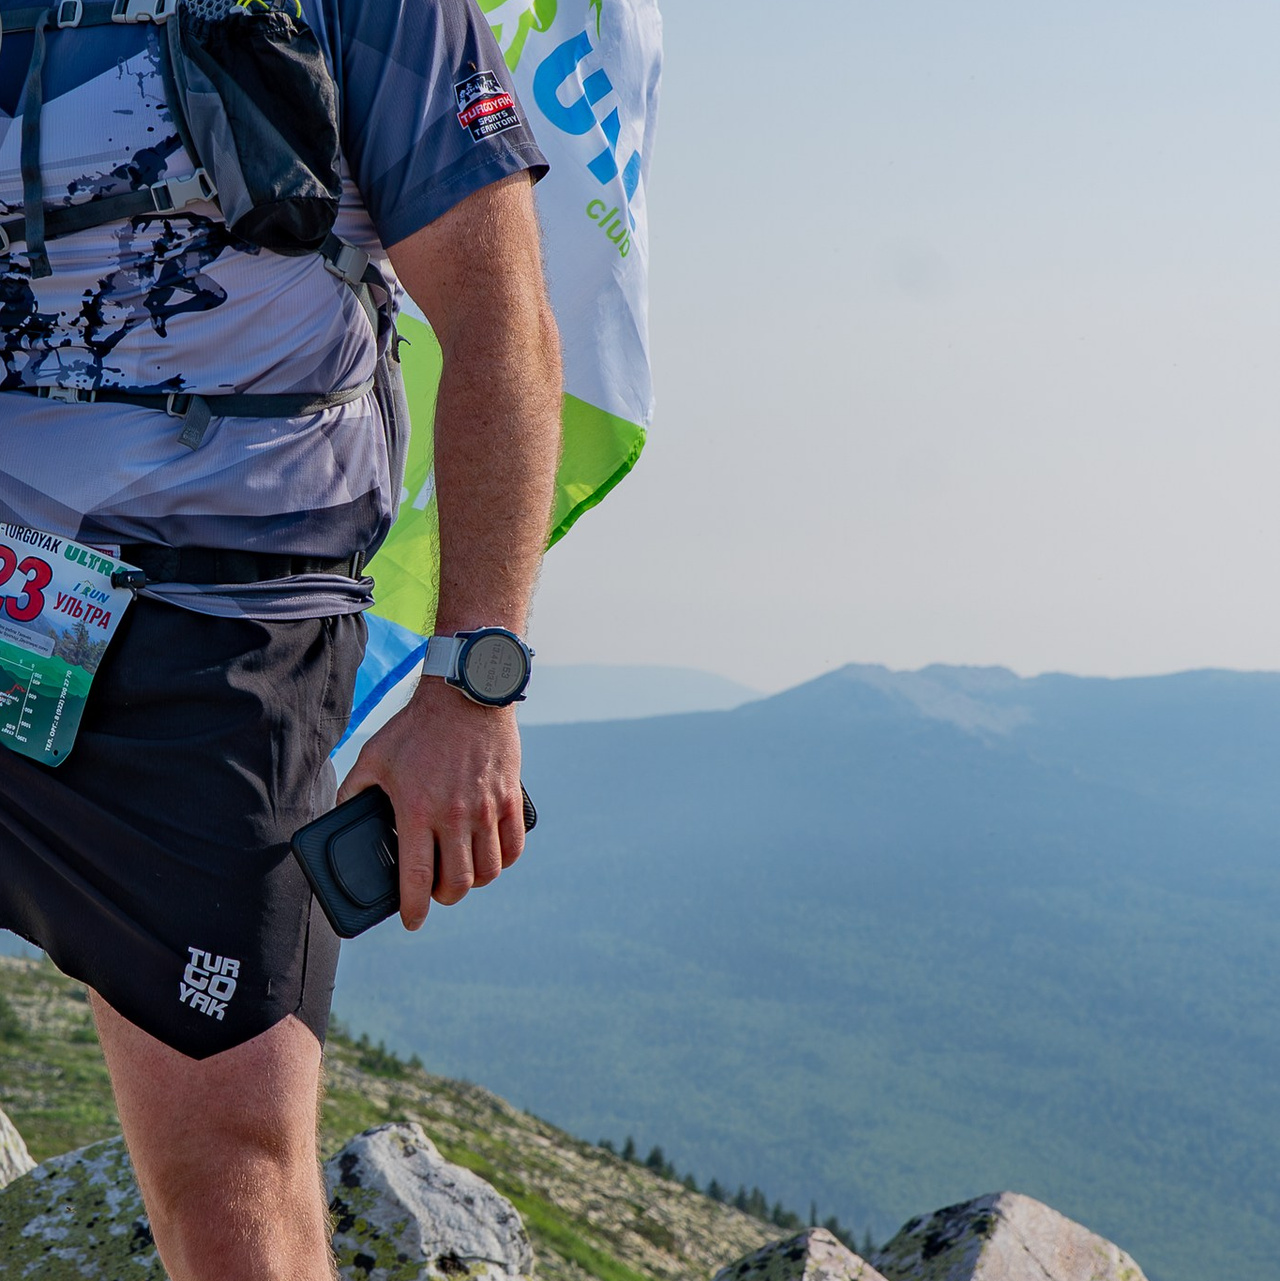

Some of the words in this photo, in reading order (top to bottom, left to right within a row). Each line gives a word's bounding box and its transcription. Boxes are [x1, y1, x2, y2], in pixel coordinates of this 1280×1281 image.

[461, 96, 513, 123] TURGOYAK
[478, 110, 509, 125] SPORTS
[474, 115, 518, 136] TERRITORY
[586, 199, 631, 258] club
[53, 592, 112, 630] УЛЬТРА
[66, 670, 72, 678] 70
[60, 688, 68, 700] 700
[56, 700, 65, 716] (922)
[188, 946, 240, 978] TUR
[179, 982, 228, 1020] YAK
